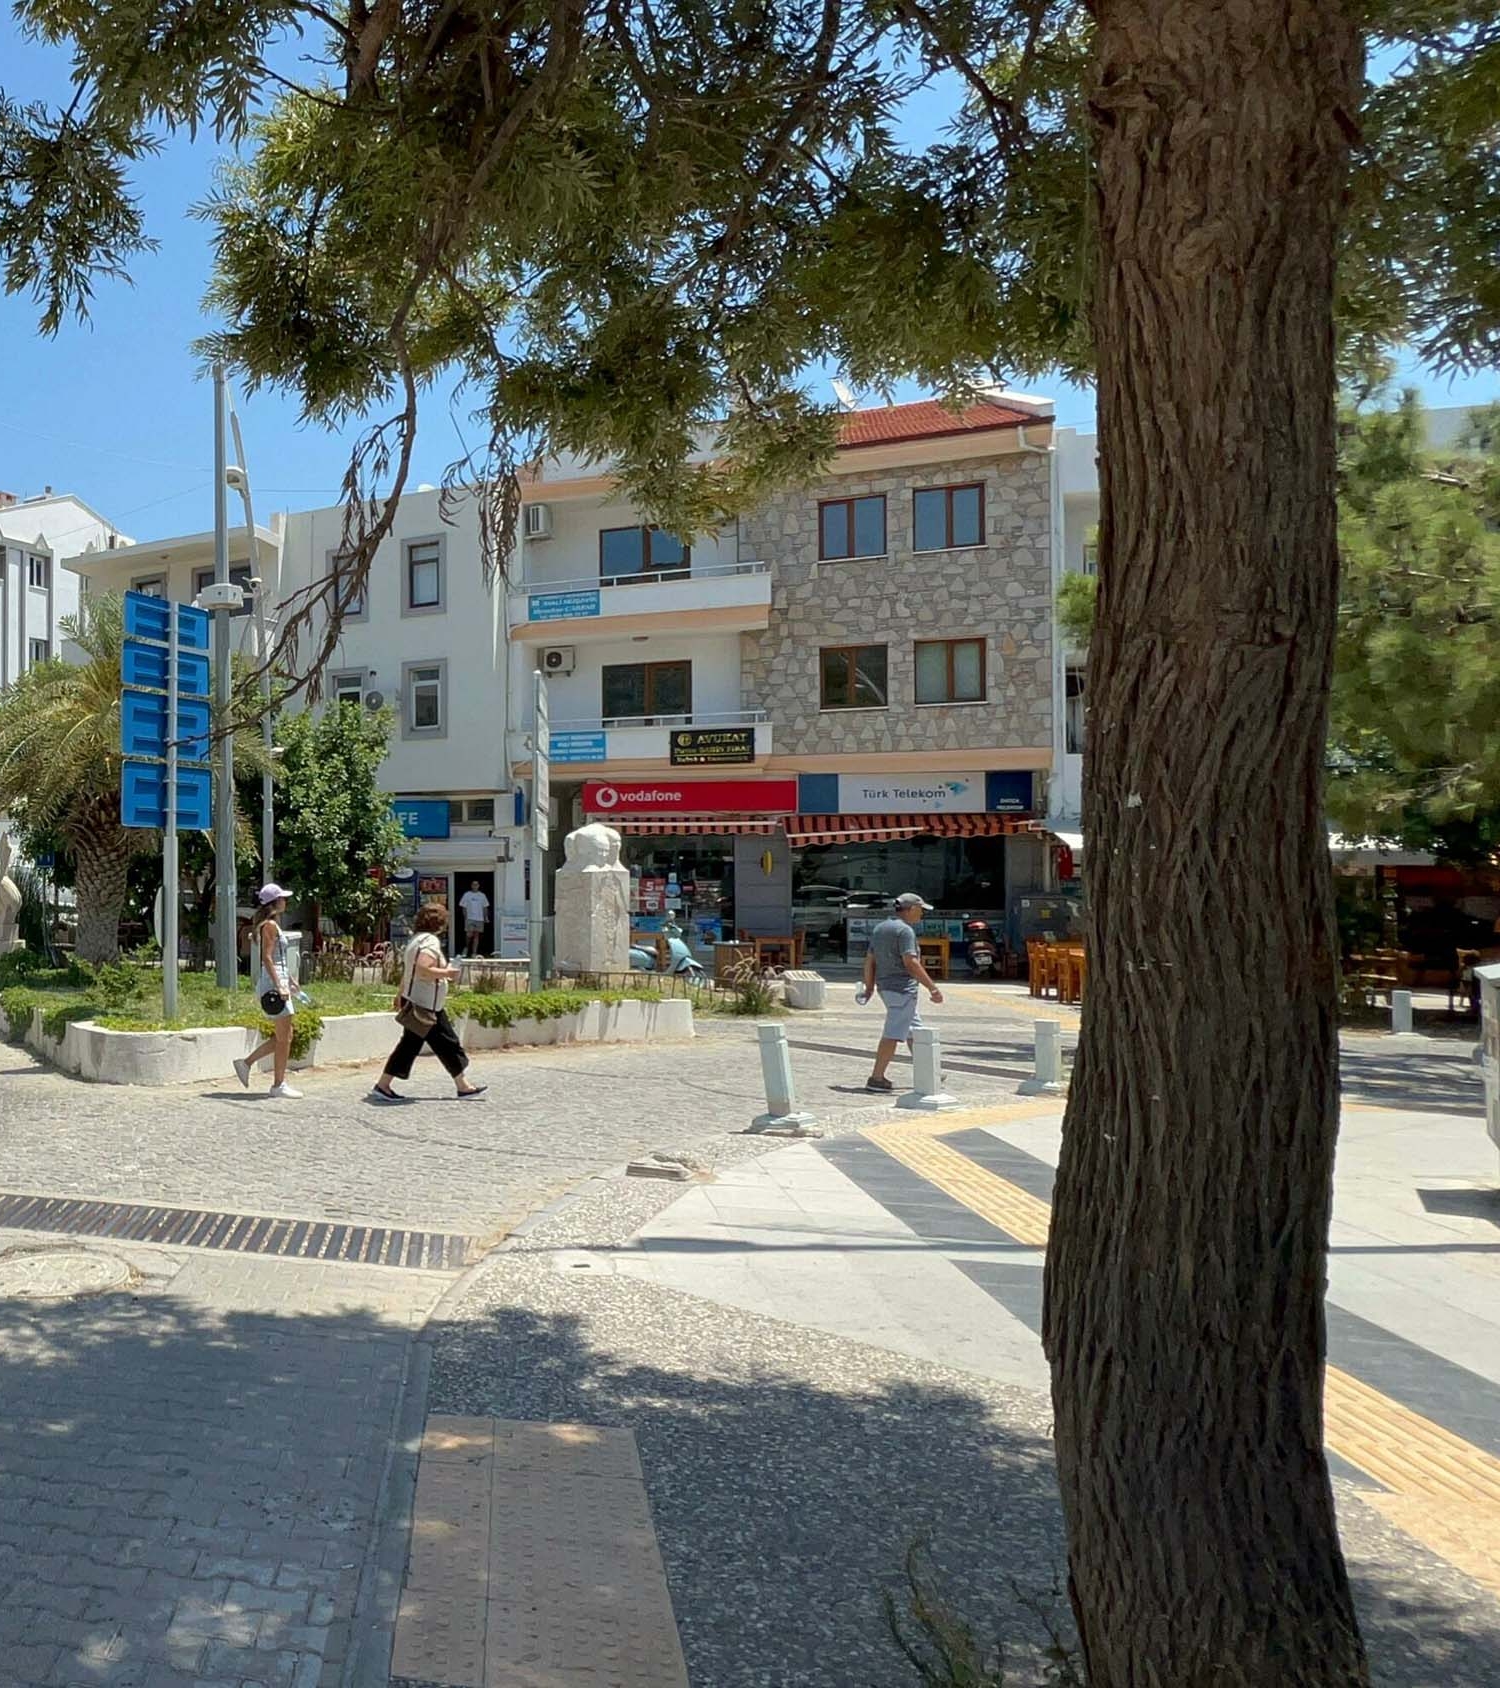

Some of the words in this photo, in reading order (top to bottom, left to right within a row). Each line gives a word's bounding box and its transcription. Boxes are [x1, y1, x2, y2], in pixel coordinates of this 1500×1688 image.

[697, 733, 748, 744] AVUKAT
[620, 790, 682, 802] vodafone
[862, 788, 888, 799] Türk
[892, 787, 946, 799] Telekom
